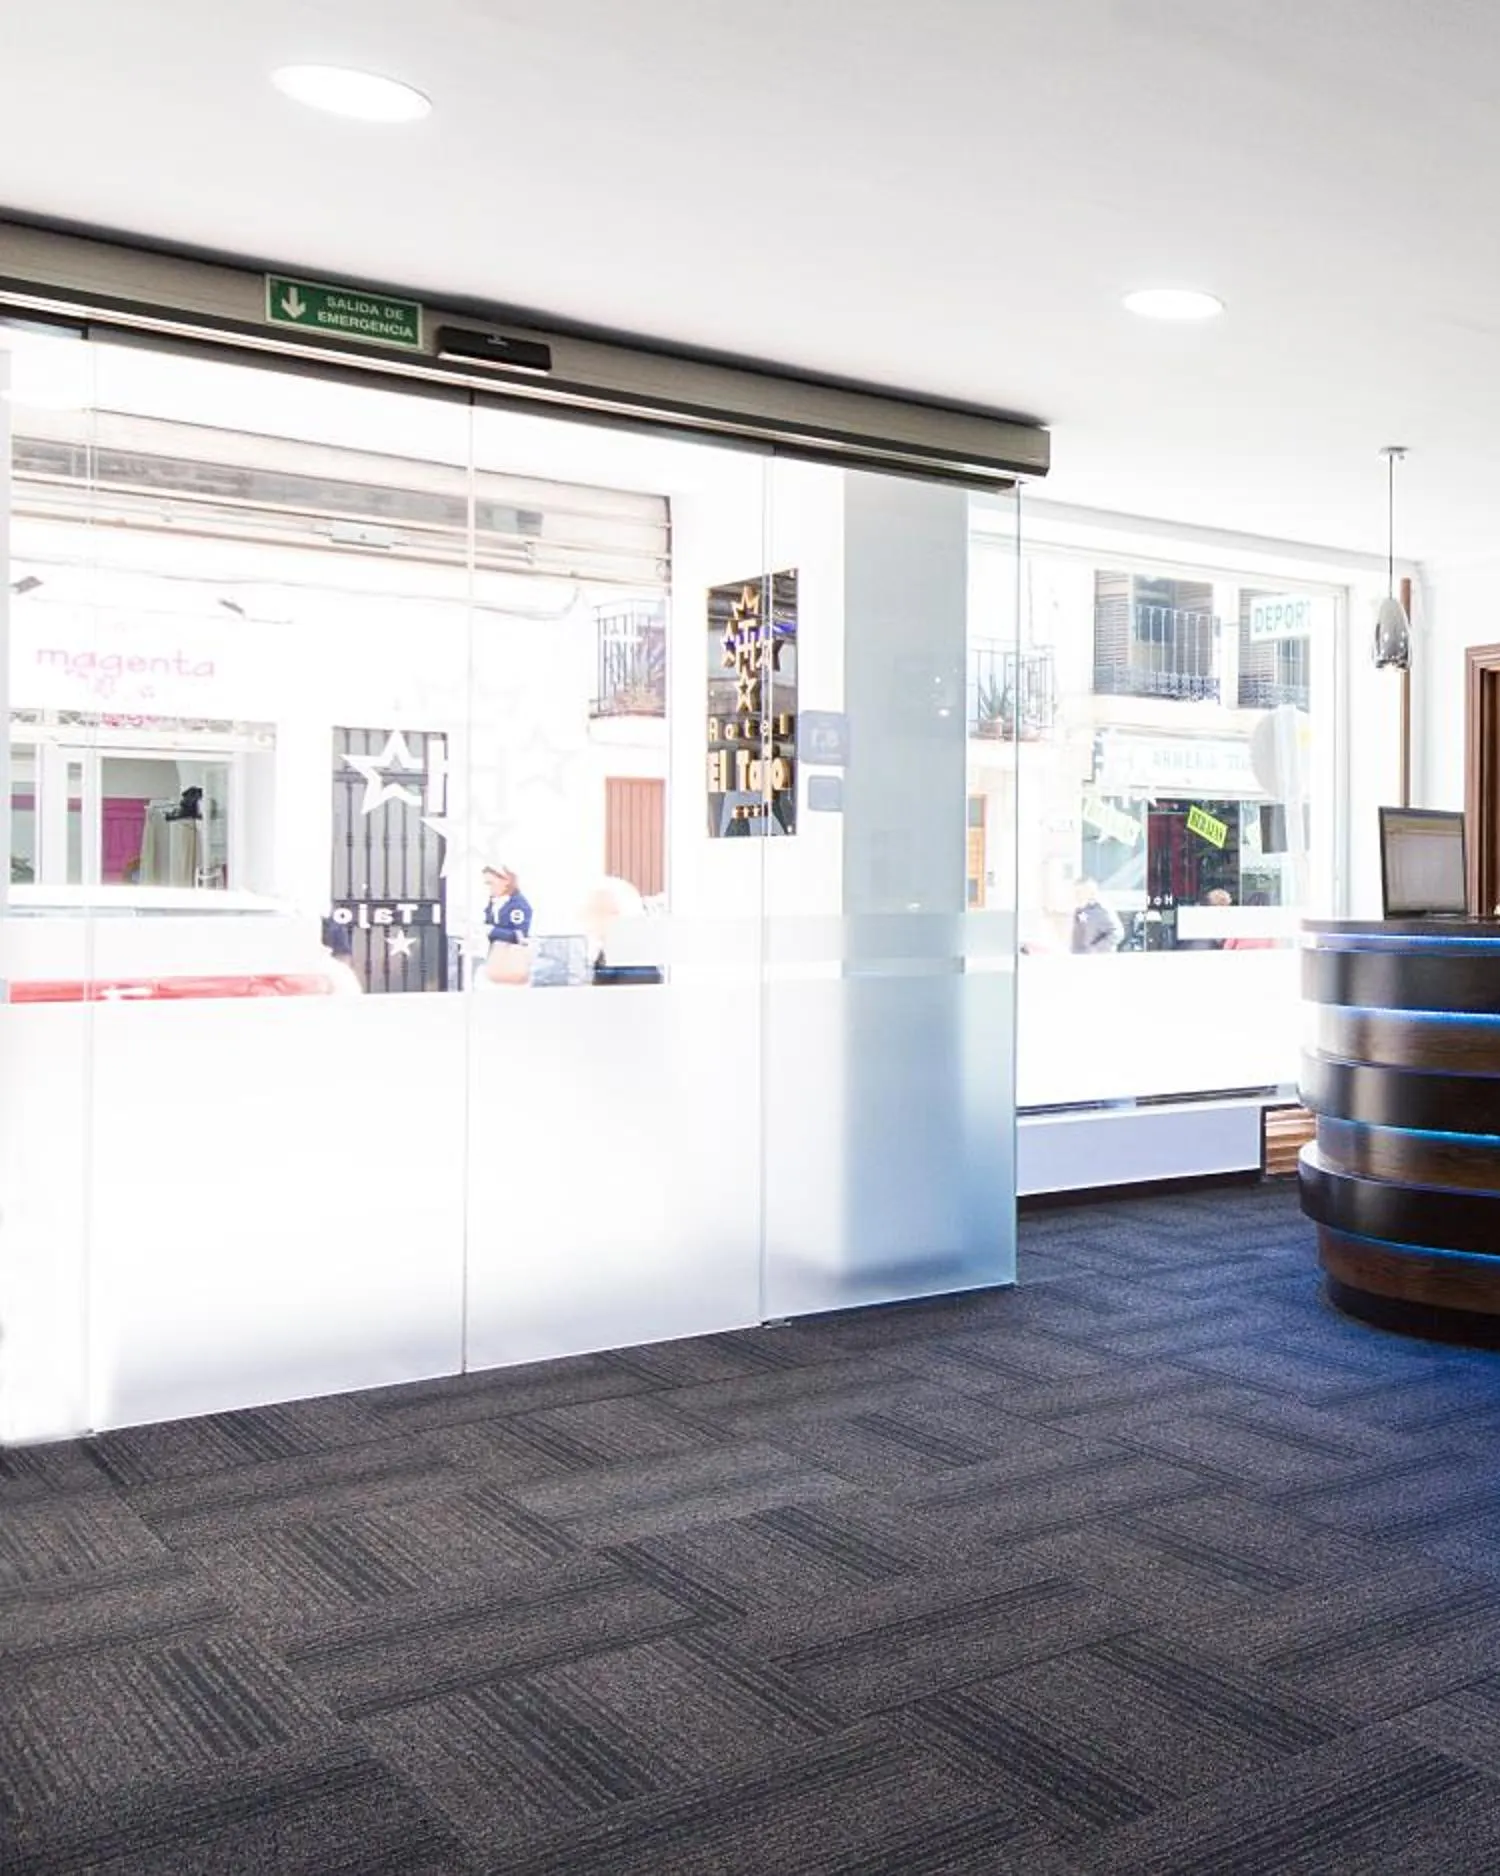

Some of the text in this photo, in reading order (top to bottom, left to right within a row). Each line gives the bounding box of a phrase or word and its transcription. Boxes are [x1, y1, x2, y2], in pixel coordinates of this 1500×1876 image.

[327, 295, 405, 321] SALIDA DE
[317, 310, 414, 338] EMERGENCIA
[36, 647, 215, 679] magenta
